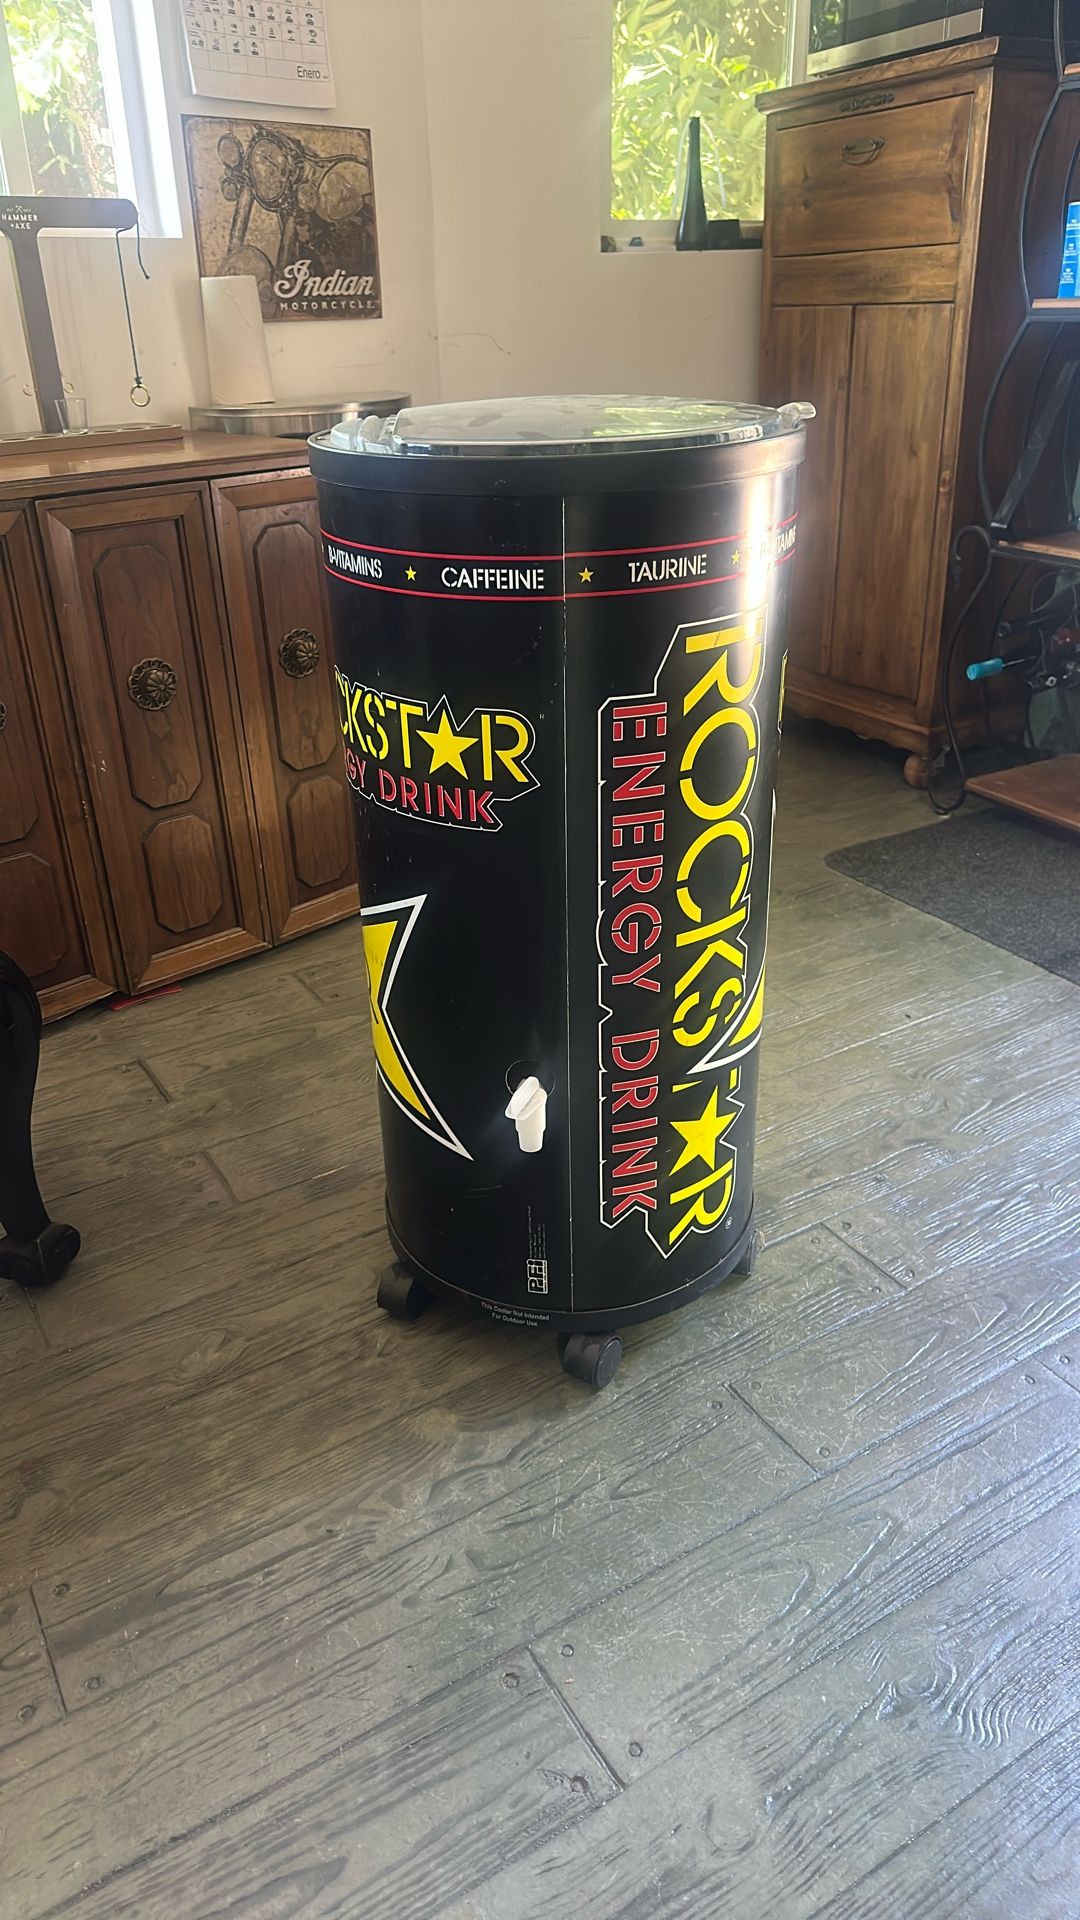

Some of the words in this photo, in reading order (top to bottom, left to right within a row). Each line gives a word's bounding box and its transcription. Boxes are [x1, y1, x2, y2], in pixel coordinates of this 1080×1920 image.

[296, 65, 321, 80] Enero
[1, 213, 38, 222] HAMMER
[273, 259, 374, 299] Indian
[280, 301, 374, 311] MOTORCYCLE
[327, 544, 383, 579] B-VITAMINS
[440, 567, 545, 591] CAFFEINE
[628, 553, 707, 584] TAURINE
[378, 767, 495, 824] DRINK
[611, 701, 668, 993] ENERGY
[611, 1028, 660, 1219] DRINK
[480, 1301, 493, 1310] This
[493, 1305, 512, 1315] Cooler
[512, 1310, 524, 1318] Not
[523, 1312, 550, 1321] Intended
[502, 1315, 525, 1325] Outdoor
[526, 1319, 539, 1327] Use
